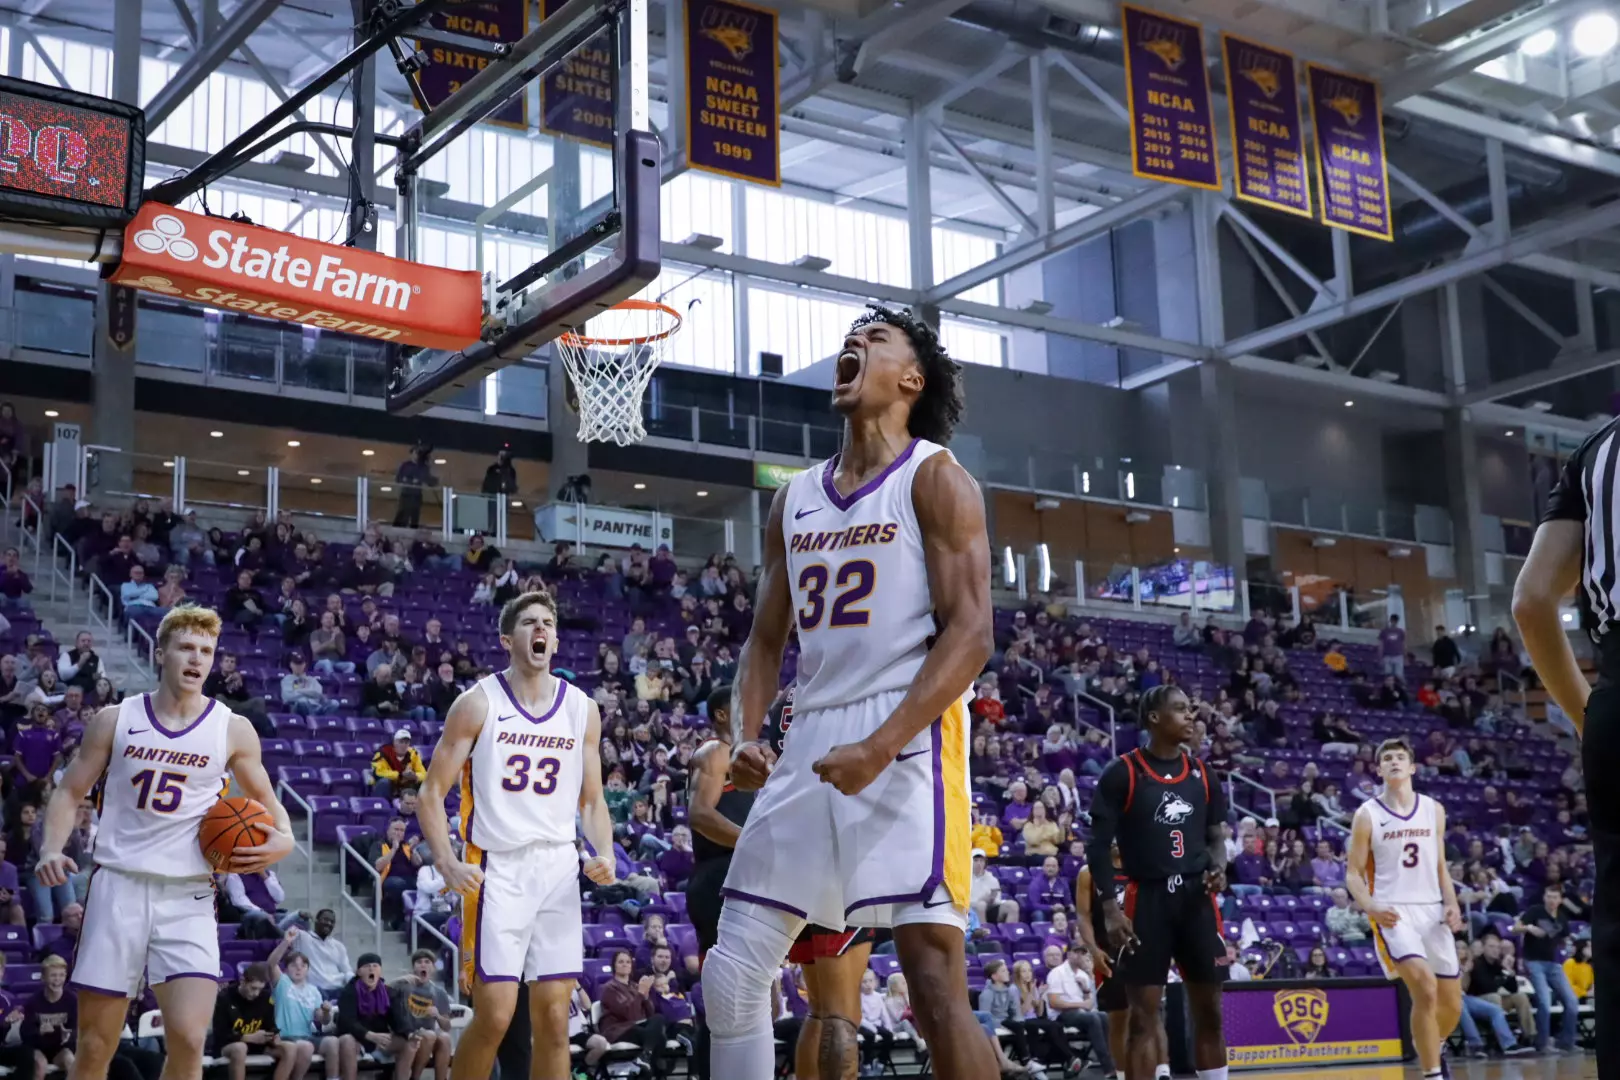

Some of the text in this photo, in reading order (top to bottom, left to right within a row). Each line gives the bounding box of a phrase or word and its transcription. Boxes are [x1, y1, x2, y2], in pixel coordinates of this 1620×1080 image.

[445, 15, 501, 38] NCAA
[706, 76, 758, 101] NCAA
[705, 94, 760, 118] SWEET
[1147, 90, 1196, 113] NCAA
[700, 109, 767, 138] SIXTEEN
[1142, 113, 1169, 128] 2011
[1248, 116, 1291, 140] NCAA
[713, 141, 752, 161] 1999
[1332, 143, 1371, 166] NCAA
[58, 427, 79, 440] 107
[593, 519, 671, 540] PANTHES
[790, 522, 899, 555] PANTHERS
[798, 558, 876, 633] 32
[496, 731, 575, 751] PANTHERS
[123, 744, 210, 769] PANTHERS
[502, 753, 562, 796] 33
[131, 768, 188, 815] 15
[1170, 830, 1184, 858] 3
[1383, 828, 1431, 841] PANTHERS
[1402, 842, 1419, 868] 3
[1280, 996, 1322, 1021] PSC
[1228, 1043, 1379, 1063] SupportThePanthers.com
